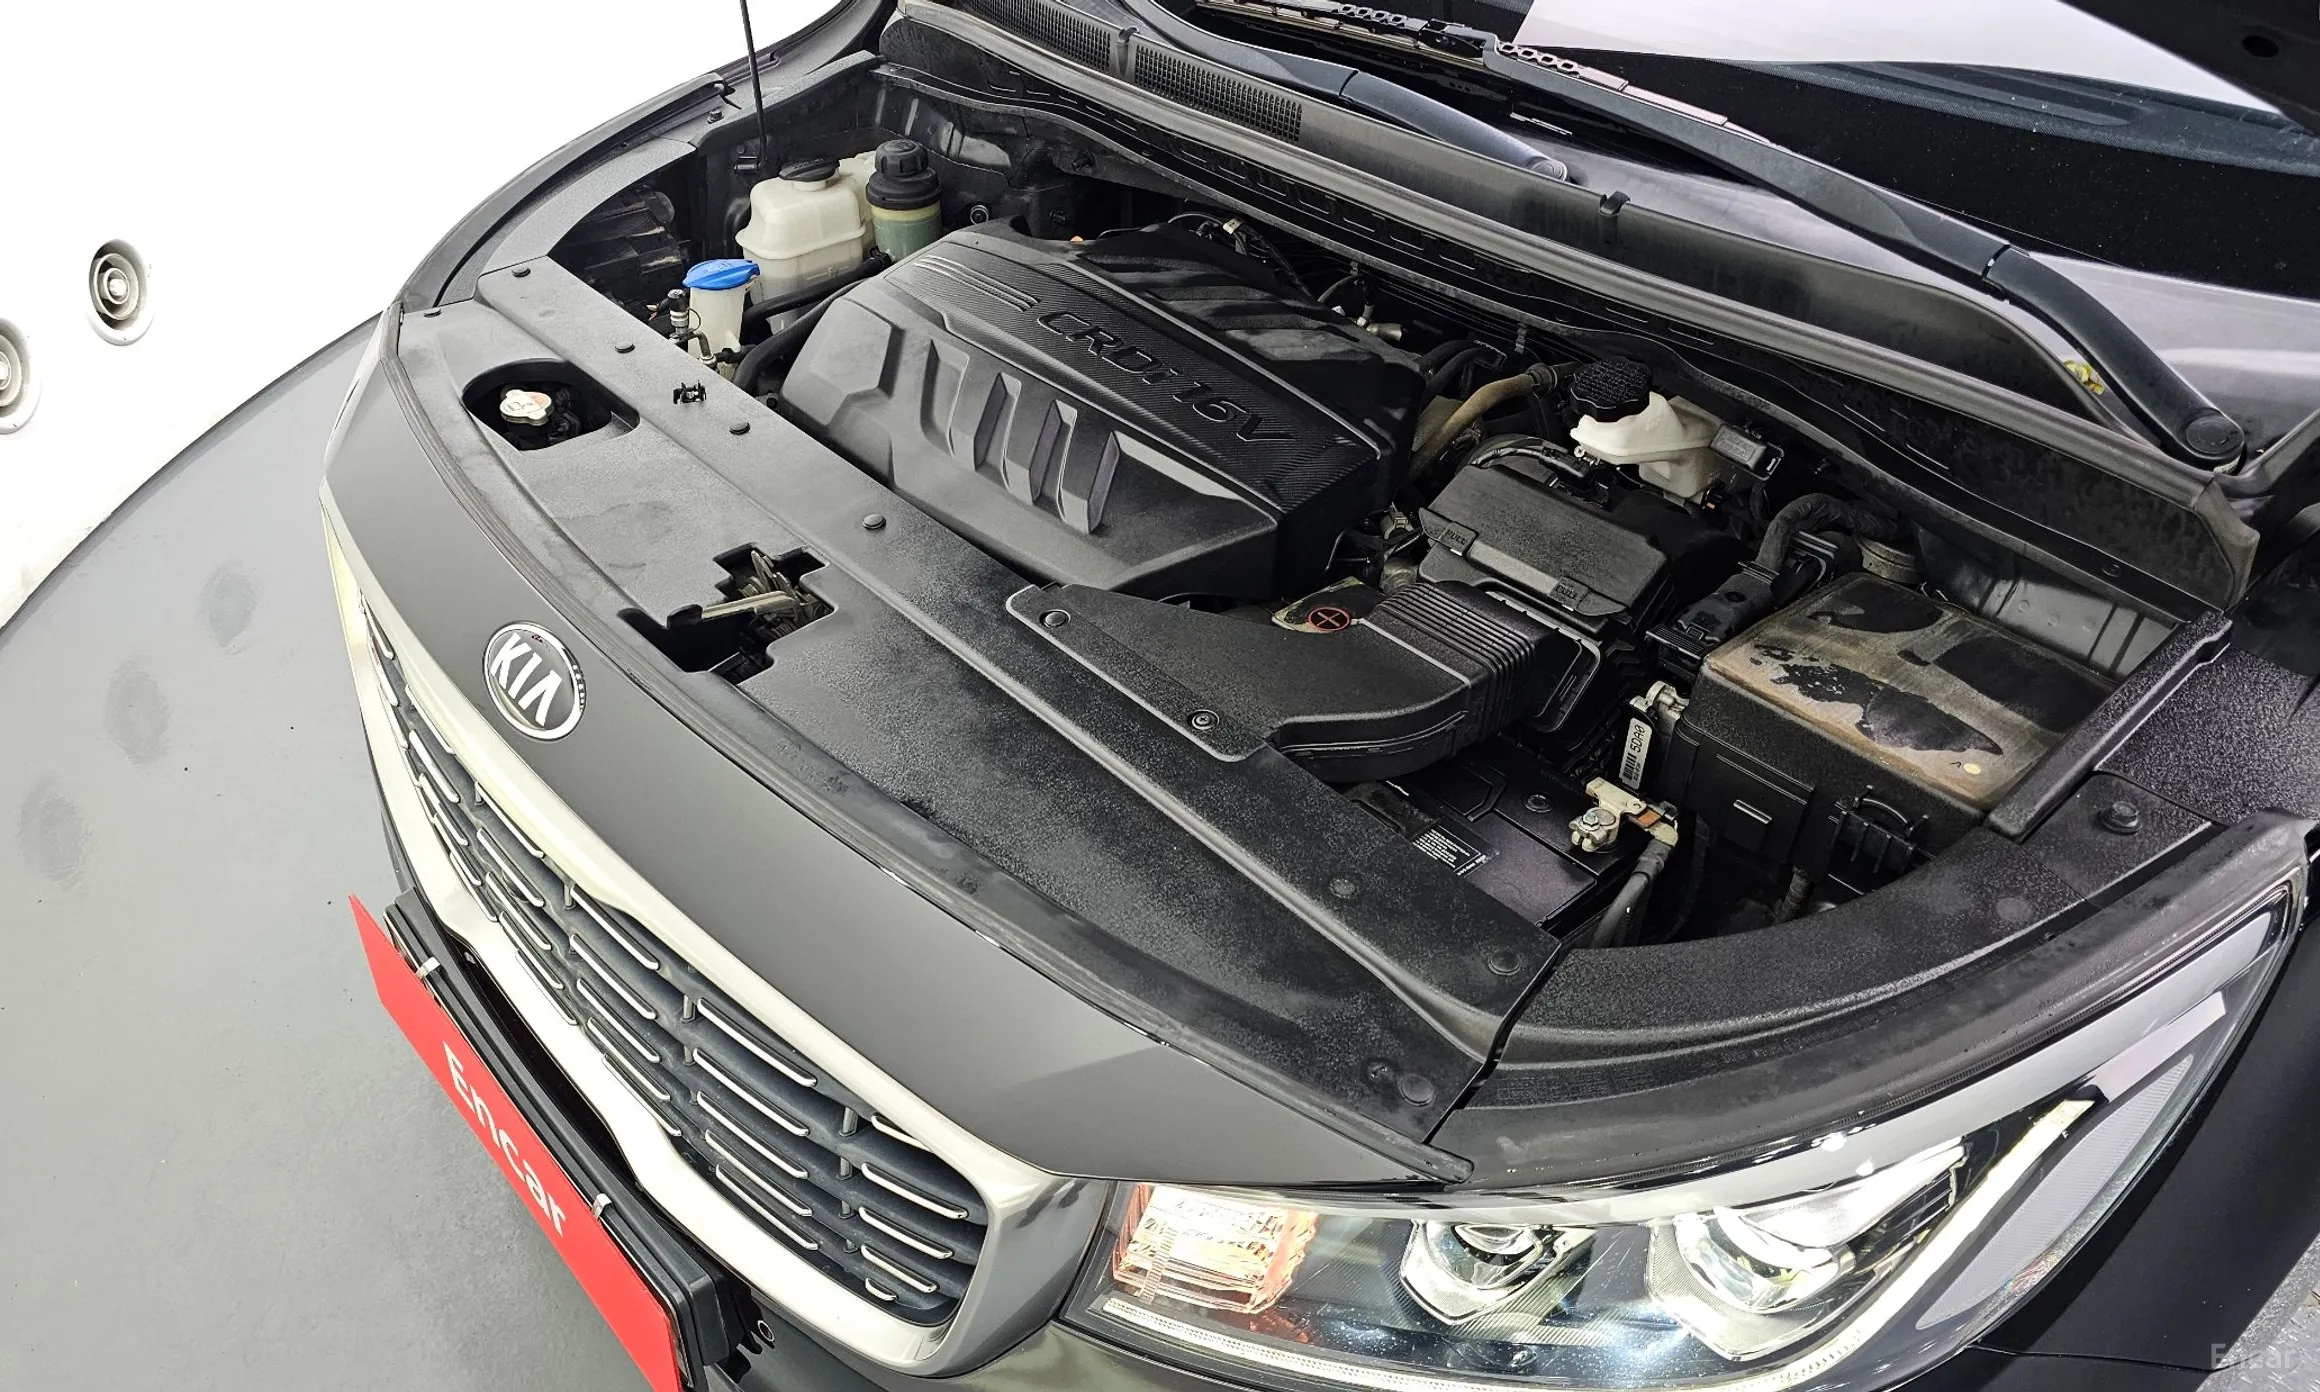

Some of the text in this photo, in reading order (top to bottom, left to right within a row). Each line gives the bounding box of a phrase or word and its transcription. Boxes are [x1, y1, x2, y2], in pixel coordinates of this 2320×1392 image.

[1172, 380, 1296, 442] 16V
[1447, 529, 1467, 546] PULL
[489, 632, 563, 727] KIA
[443, 1040, 566, 1238] Encar
